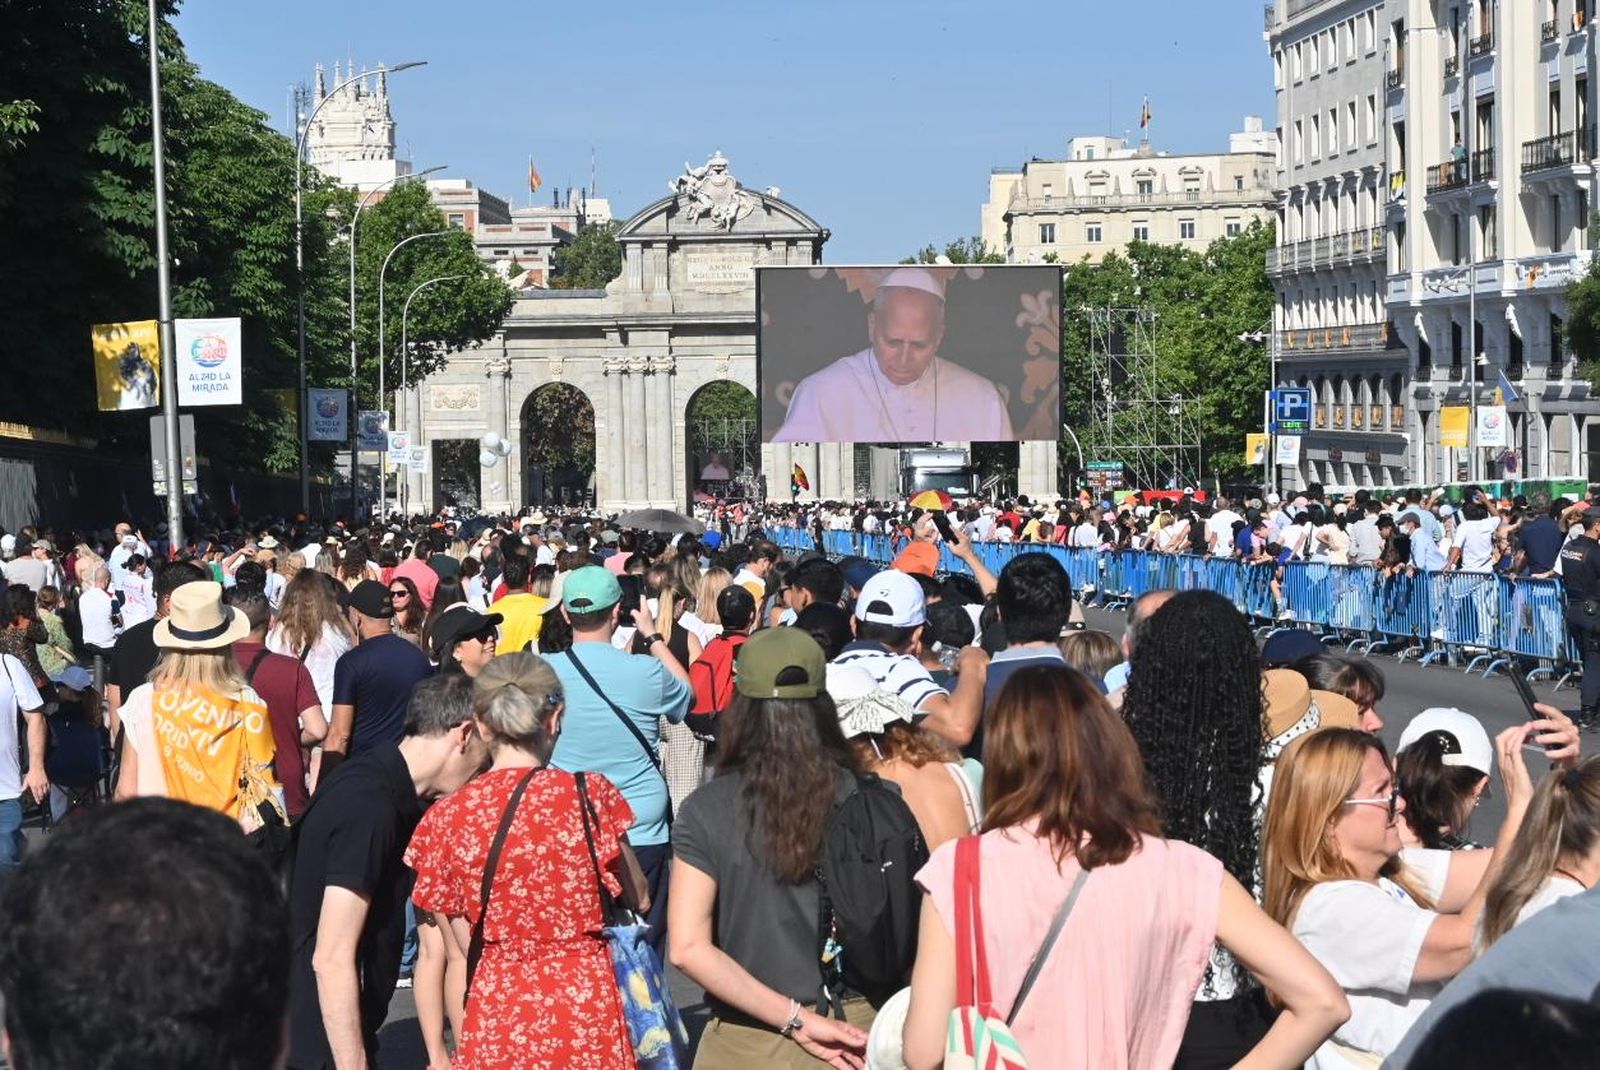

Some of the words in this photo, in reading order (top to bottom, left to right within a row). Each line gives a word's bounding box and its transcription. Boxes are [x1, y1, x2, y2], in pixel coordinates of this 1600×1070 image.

[219, 372, 231, 381] LA
[192, 383, 229, 393] MIRADA
[1284, 393, 1302, 417] P
